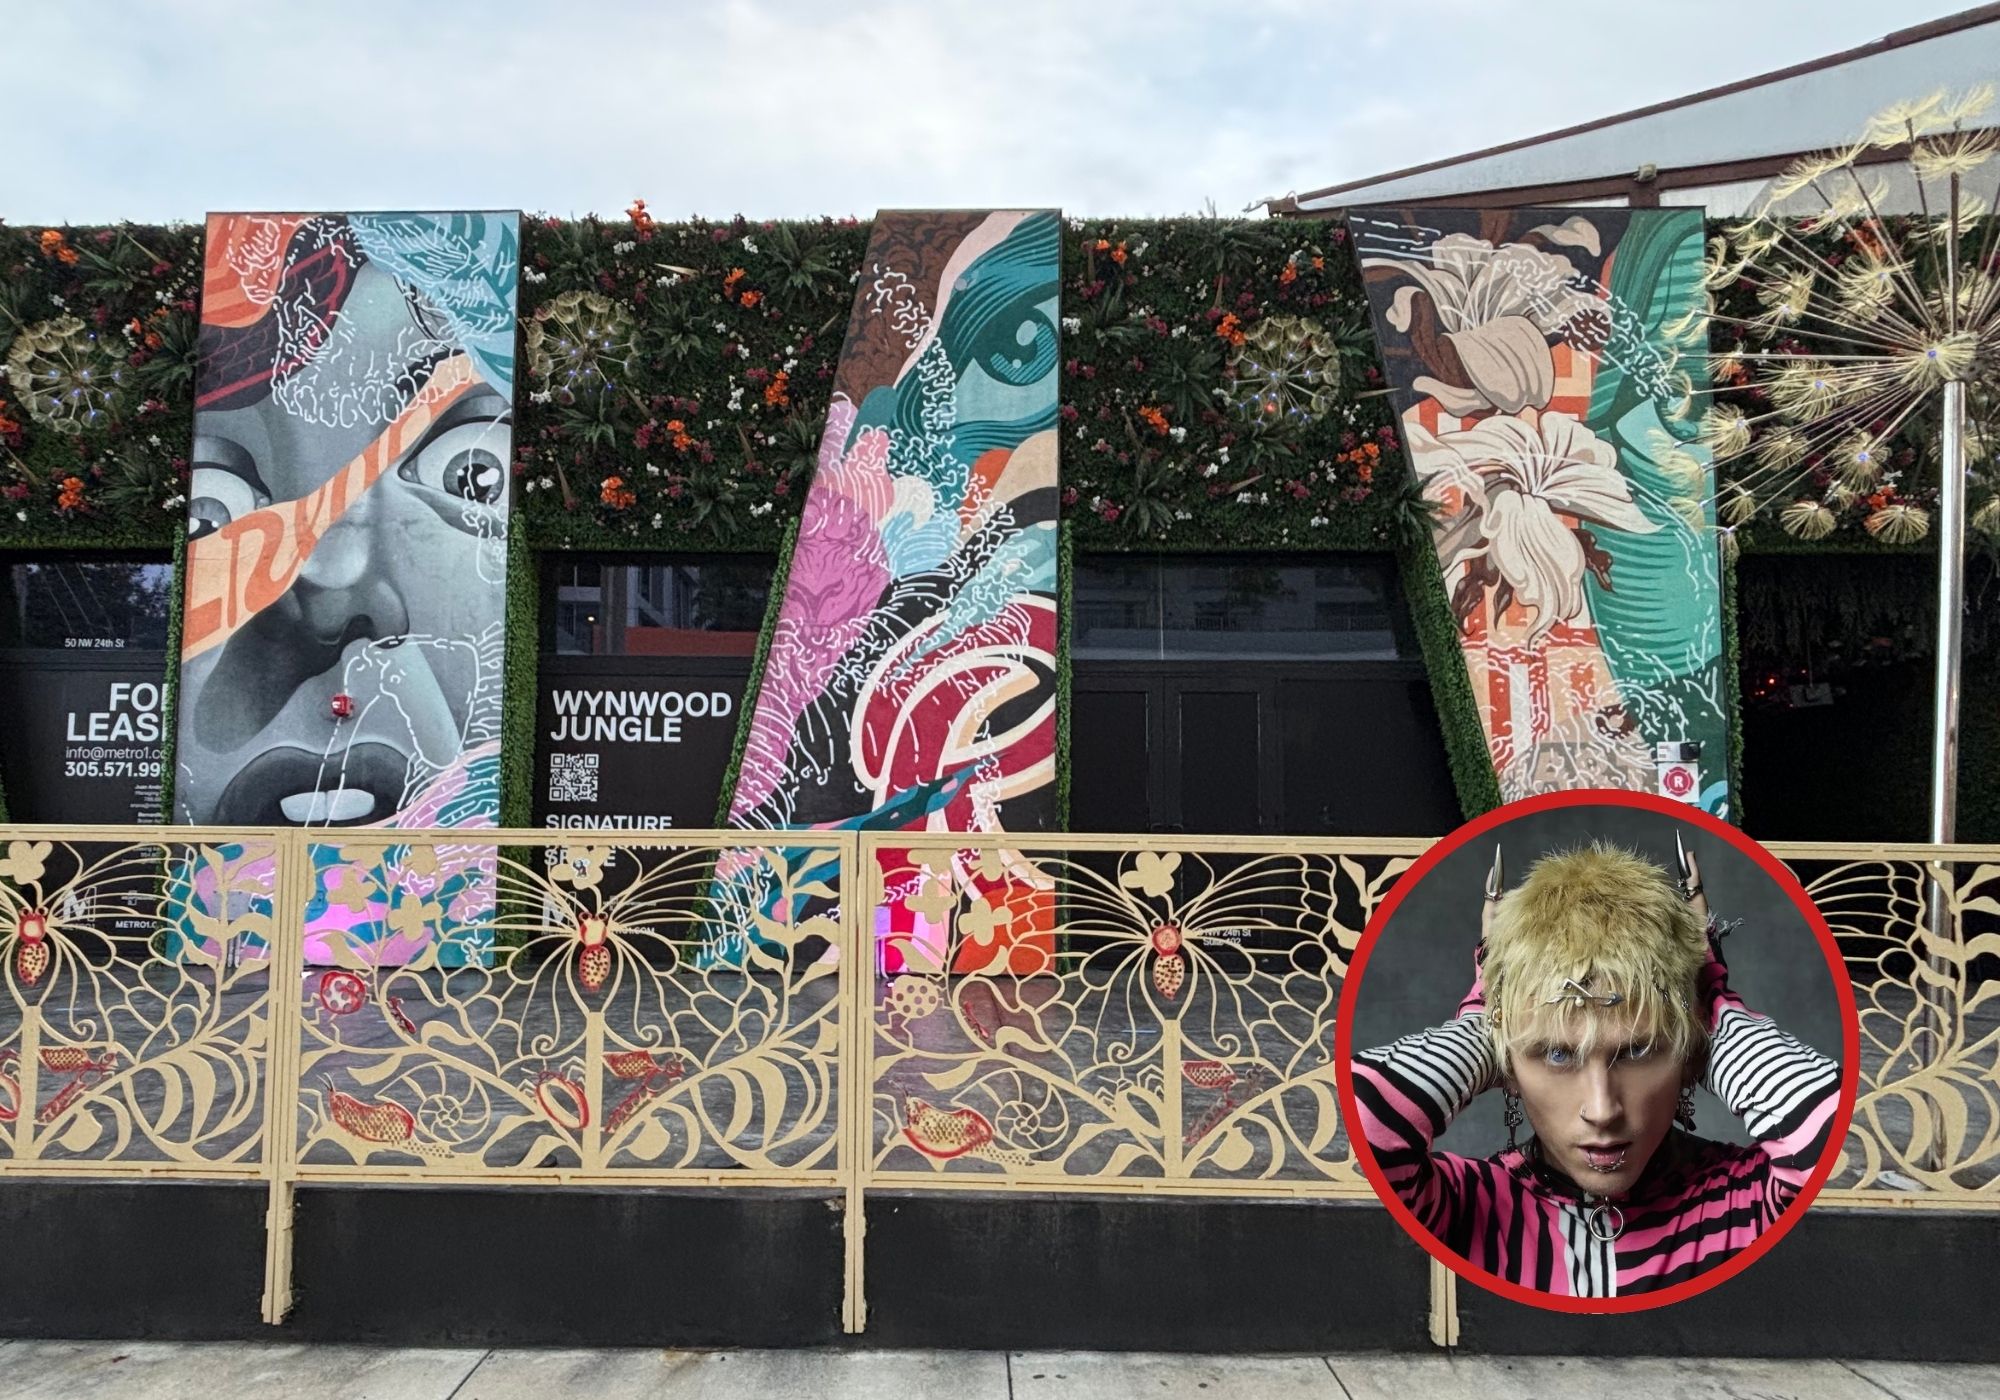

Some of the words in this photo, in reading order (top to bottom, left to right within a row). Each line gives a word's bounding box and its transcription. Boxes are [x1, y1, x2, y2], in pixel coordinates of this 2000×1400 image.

[64, 638, 77, 648] 50
[78, 638, 93, 648] NW
[94, 638, 114, 648] 24th
[115, 638, 125, 648] St
[552, 690, 732, 717] WYNWOOD
[550, 716, 682, 742] JUNGLE
[1673, 776, 1684, 788] R
[545, 814, 673, 830] SIGNATURE
